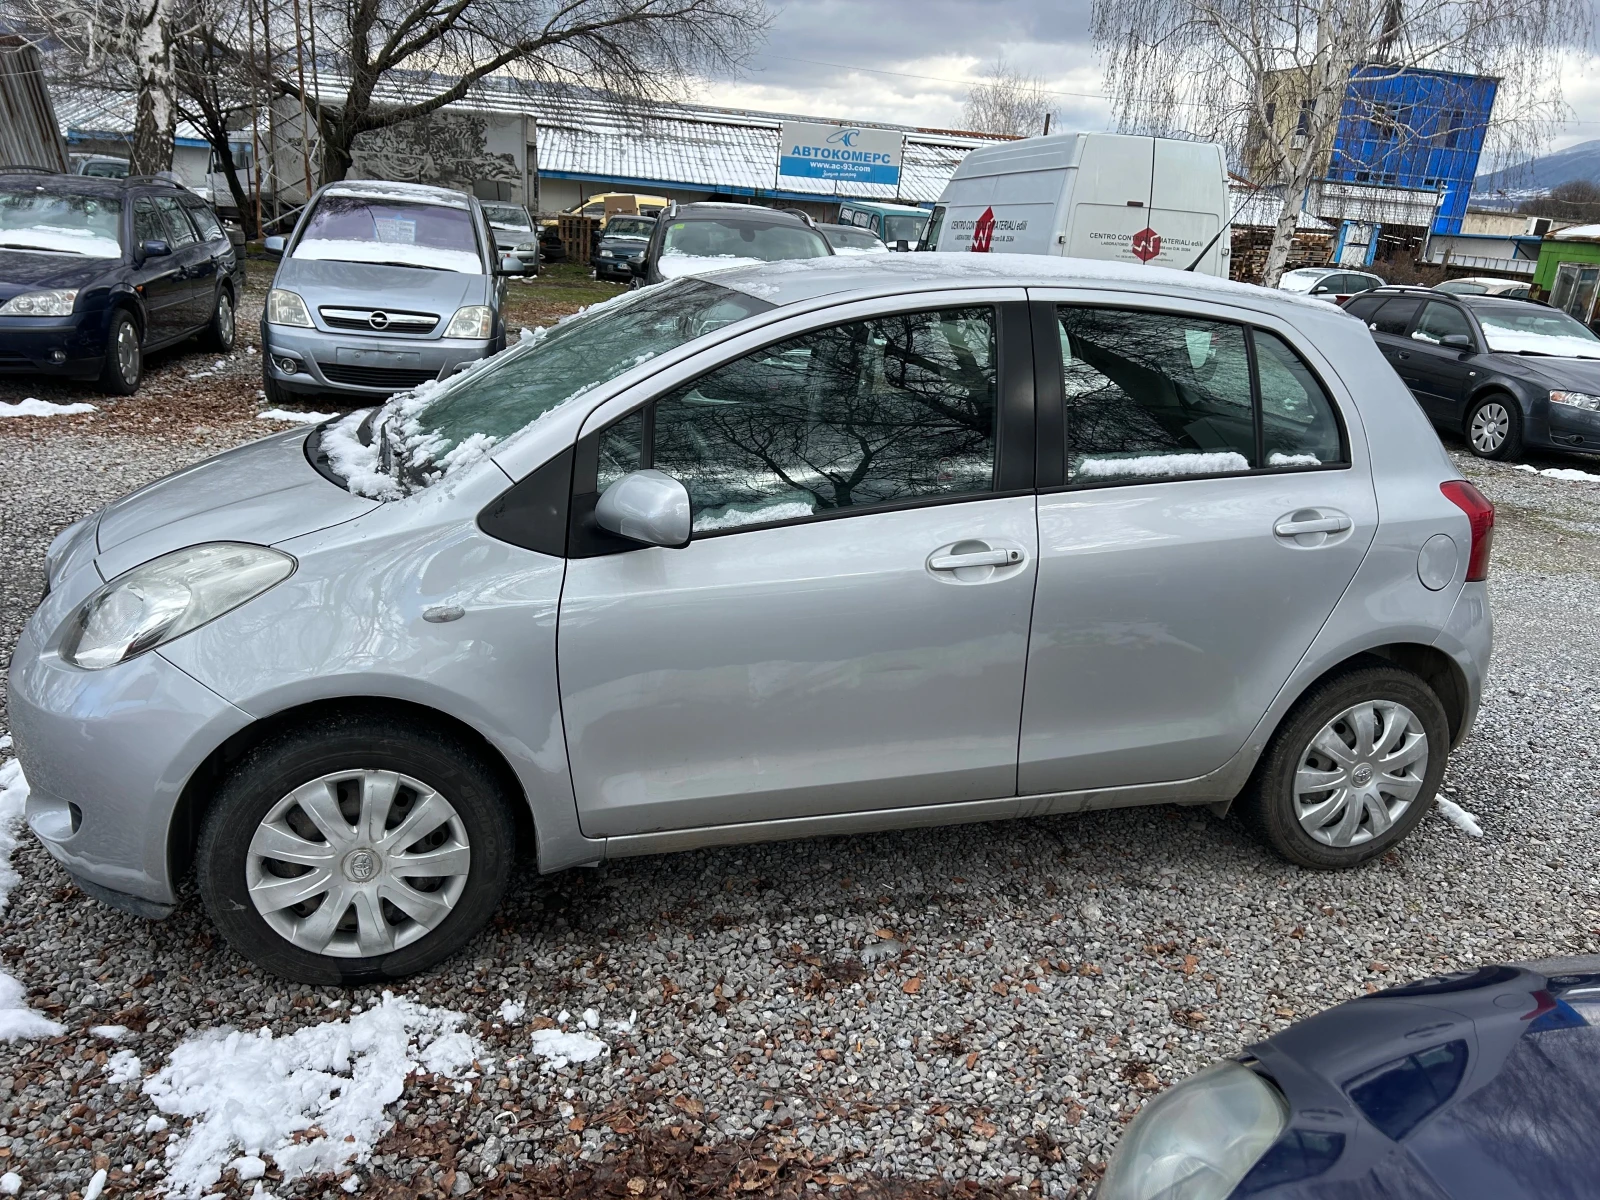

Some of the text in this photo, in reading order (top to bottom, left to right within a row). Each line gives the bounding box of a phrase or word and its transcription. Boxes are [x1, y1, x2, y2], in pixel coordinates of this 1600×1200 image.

[791, 145, 891, 164] АВТОКОМЕРС
[810, 161, 871, 173] www.ac-93.com
[951, 220, 965, 230] CENTRO
[1089, 232, 1117, 240] CENTRO
[1158, 236, 1190, 246] MATERIALI
